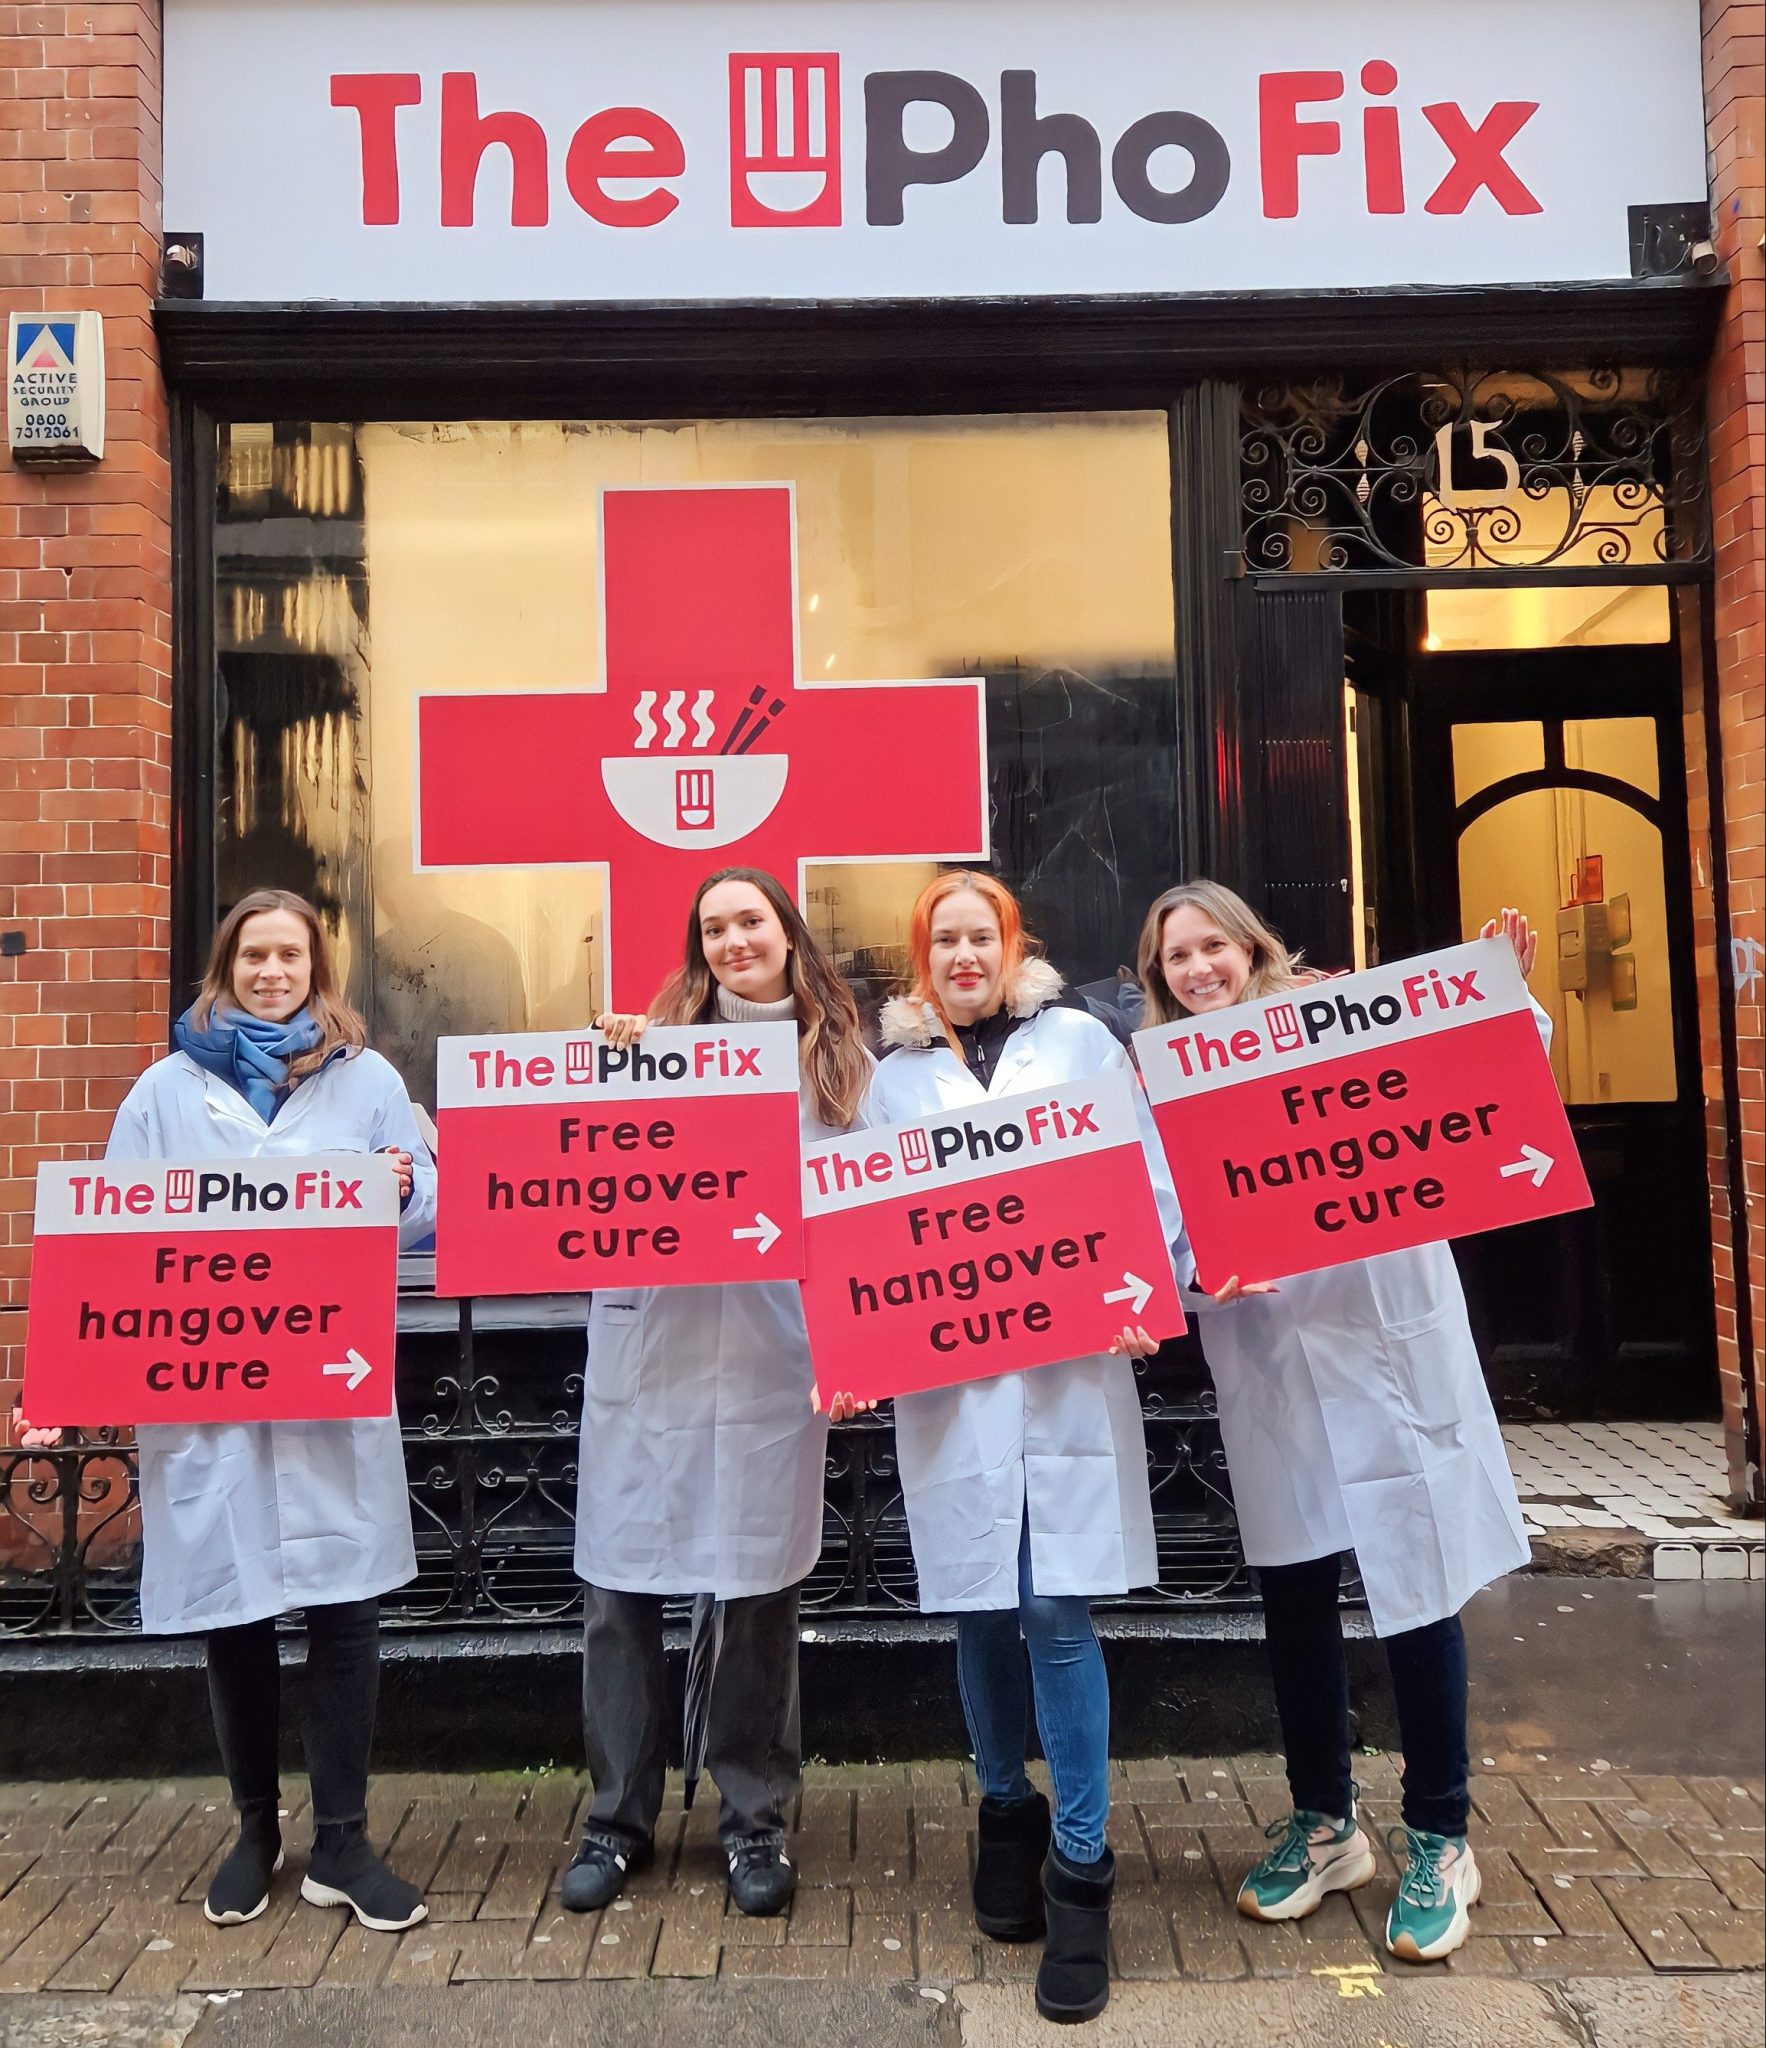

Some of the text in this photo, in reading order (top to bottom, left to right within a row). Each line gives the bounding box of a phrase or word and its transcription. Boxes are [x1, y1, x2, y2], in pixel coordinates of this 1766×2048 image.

[330, 59, 1543, 228] The Pho Fix
[14, 373, 77, 383] ACTIVE
[20, 397, 69, 406] GROUP
[26, 414, 66, 426] 0800
[1435, 419, 1521, 515] 15
[1167, 968, 1485, 1077] The Pho Fix
[468, 1039, 762, 1089] The Pho Fix
[1280, 1068, 1409, 1126] Free
[560, 1117, 675, 1154] Free
[807, 1100, 1099, 1195] The Pho Fix
[1222, 1103, 1501, 1198] hangover
[68, 1170, 363, 1216] The Pho Fix
[487, 1169, 749, 1215] hangover
[1313, 1177, 1446, 1234] cure
[557, 1225, 680, 1260] cure
[907, 1194, 1025, 1246] Free
[155, 1247, 272, 1284] Free
[848, 1231, 1108, 1316] hangover
[78, 1301, 343, 1347] hangover
[929, 1301, 1053, 1352] cure
[145, 1359, 270, 1392] cure
